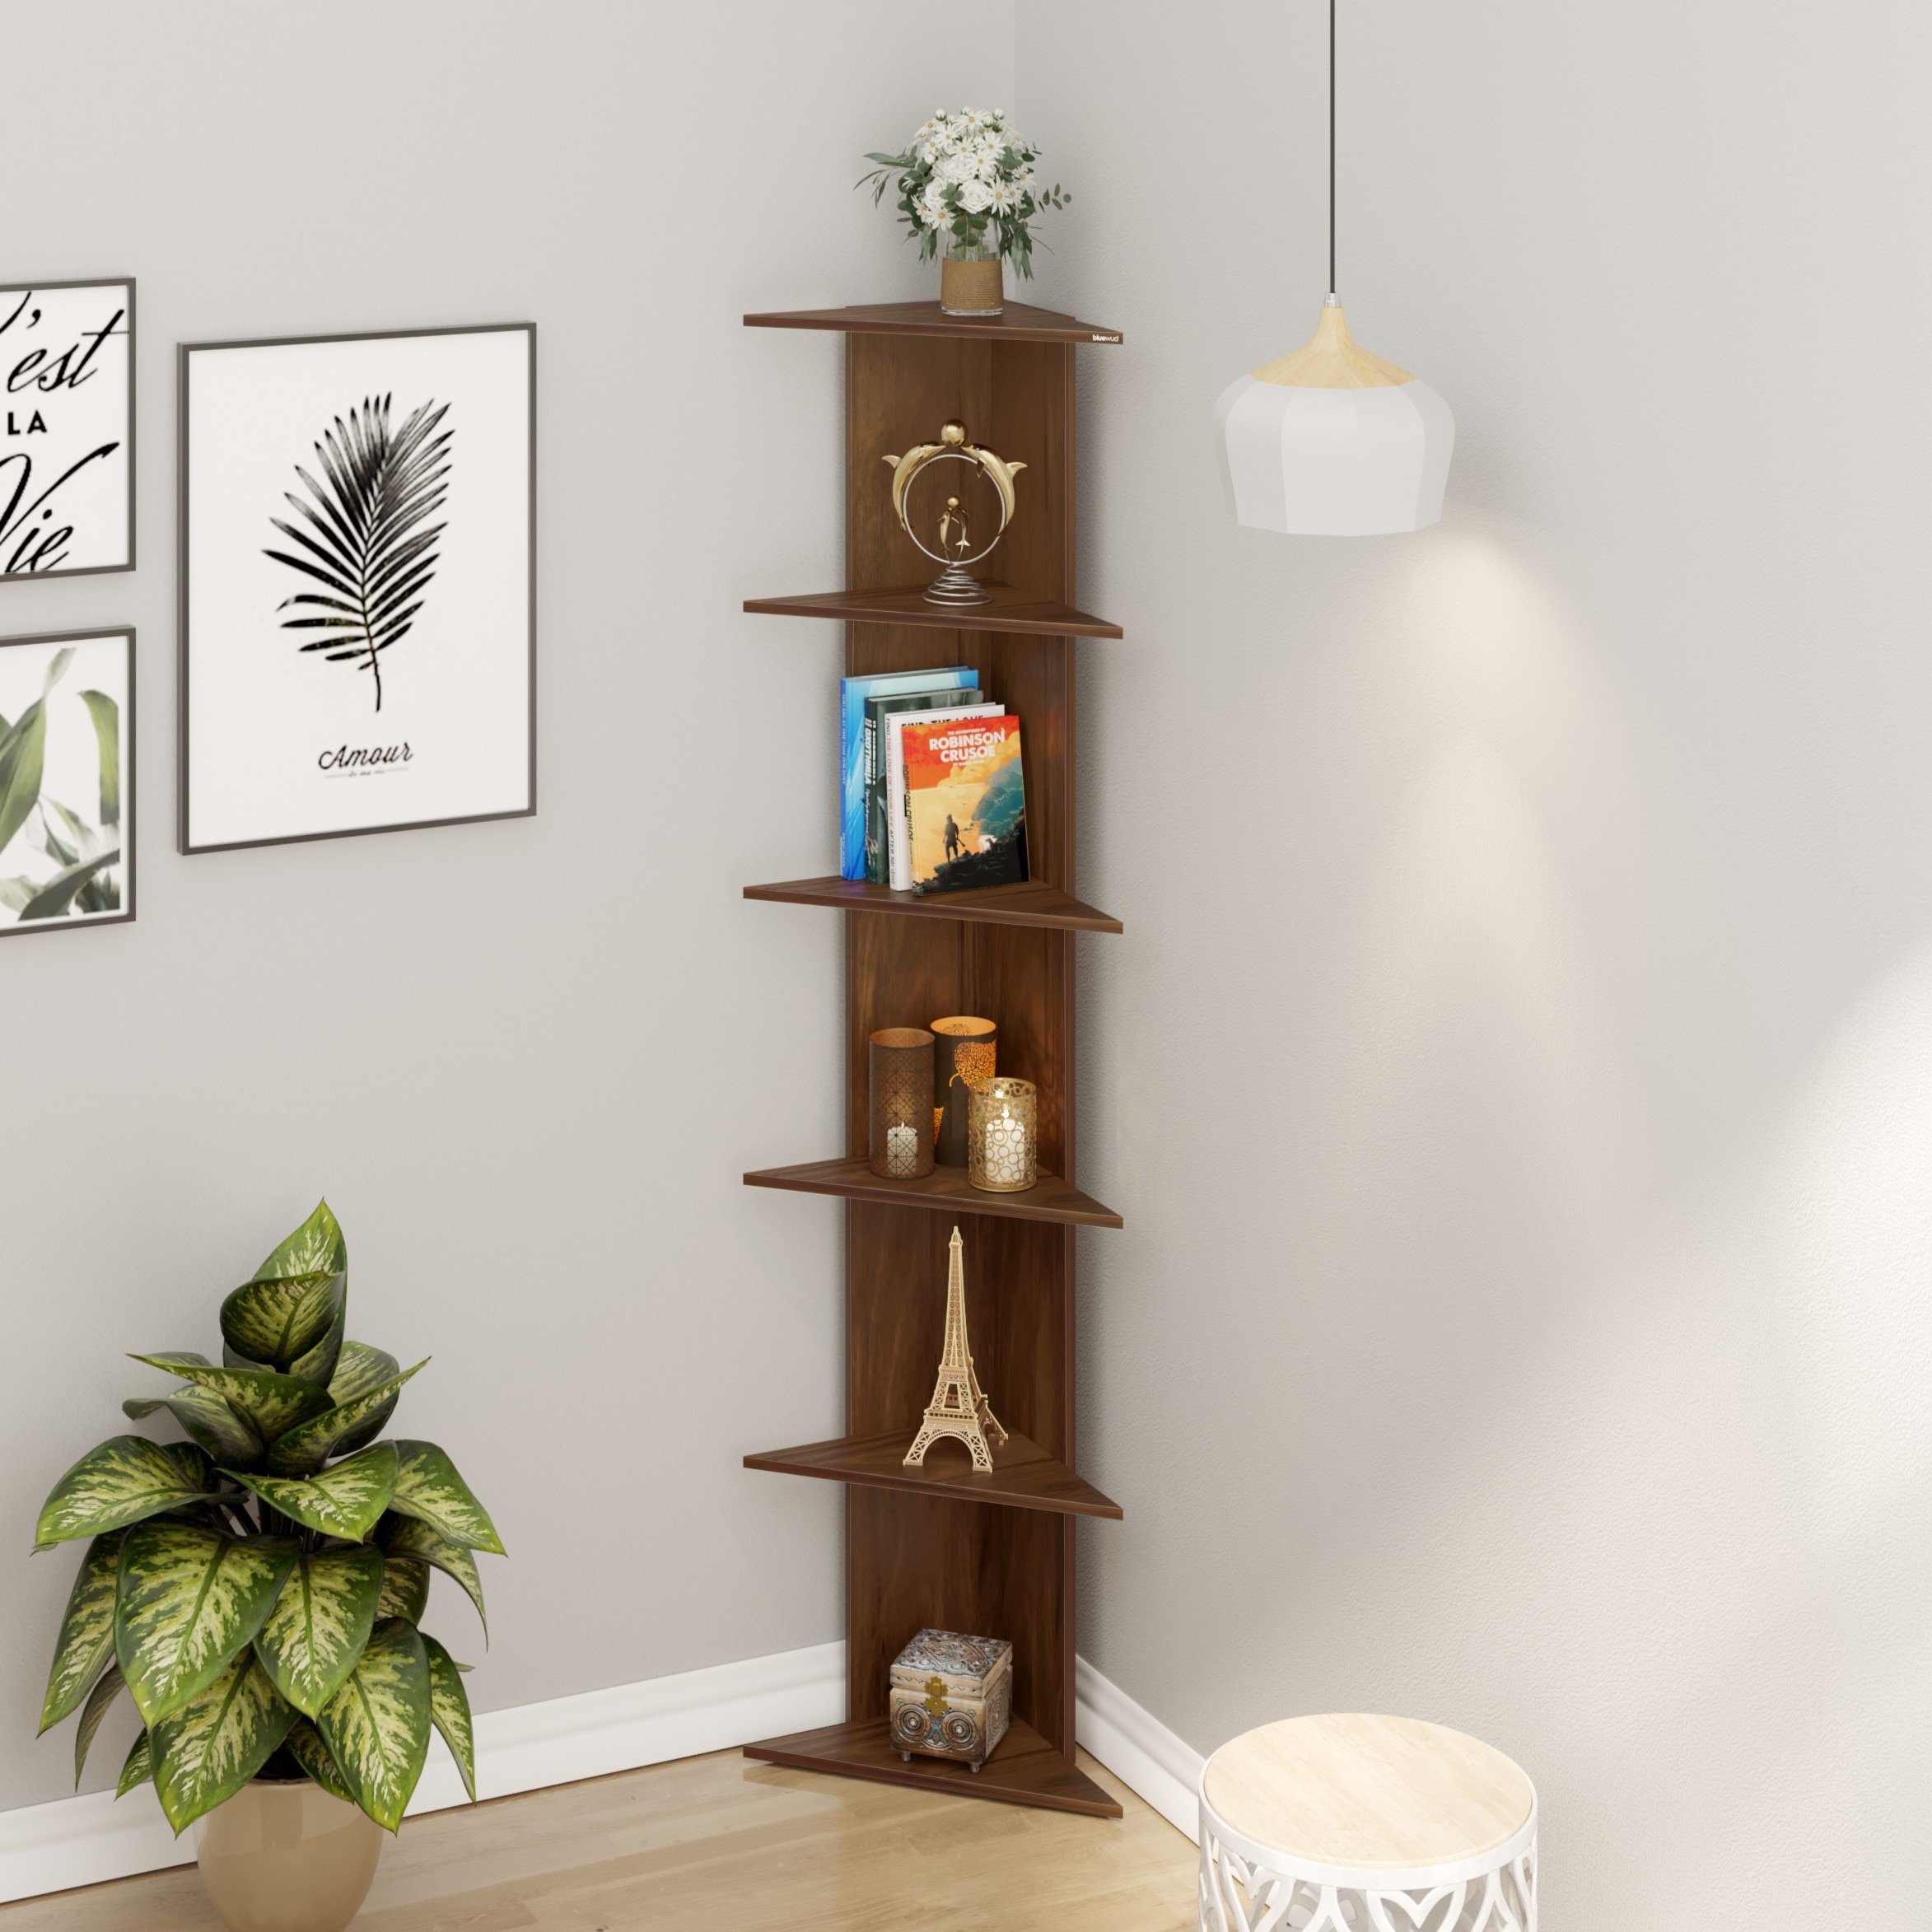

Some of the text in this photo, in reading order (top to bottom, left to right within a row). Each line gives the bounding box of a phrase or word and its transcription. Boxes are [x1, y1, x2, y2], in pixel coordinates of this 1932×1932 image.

[0, 292, 129, 393] 'est
[929, 727, 1006, 751] ROBINSON
[319, 741, 413, 770] Amour
[940, 744, 996, 763] CRUSOE
